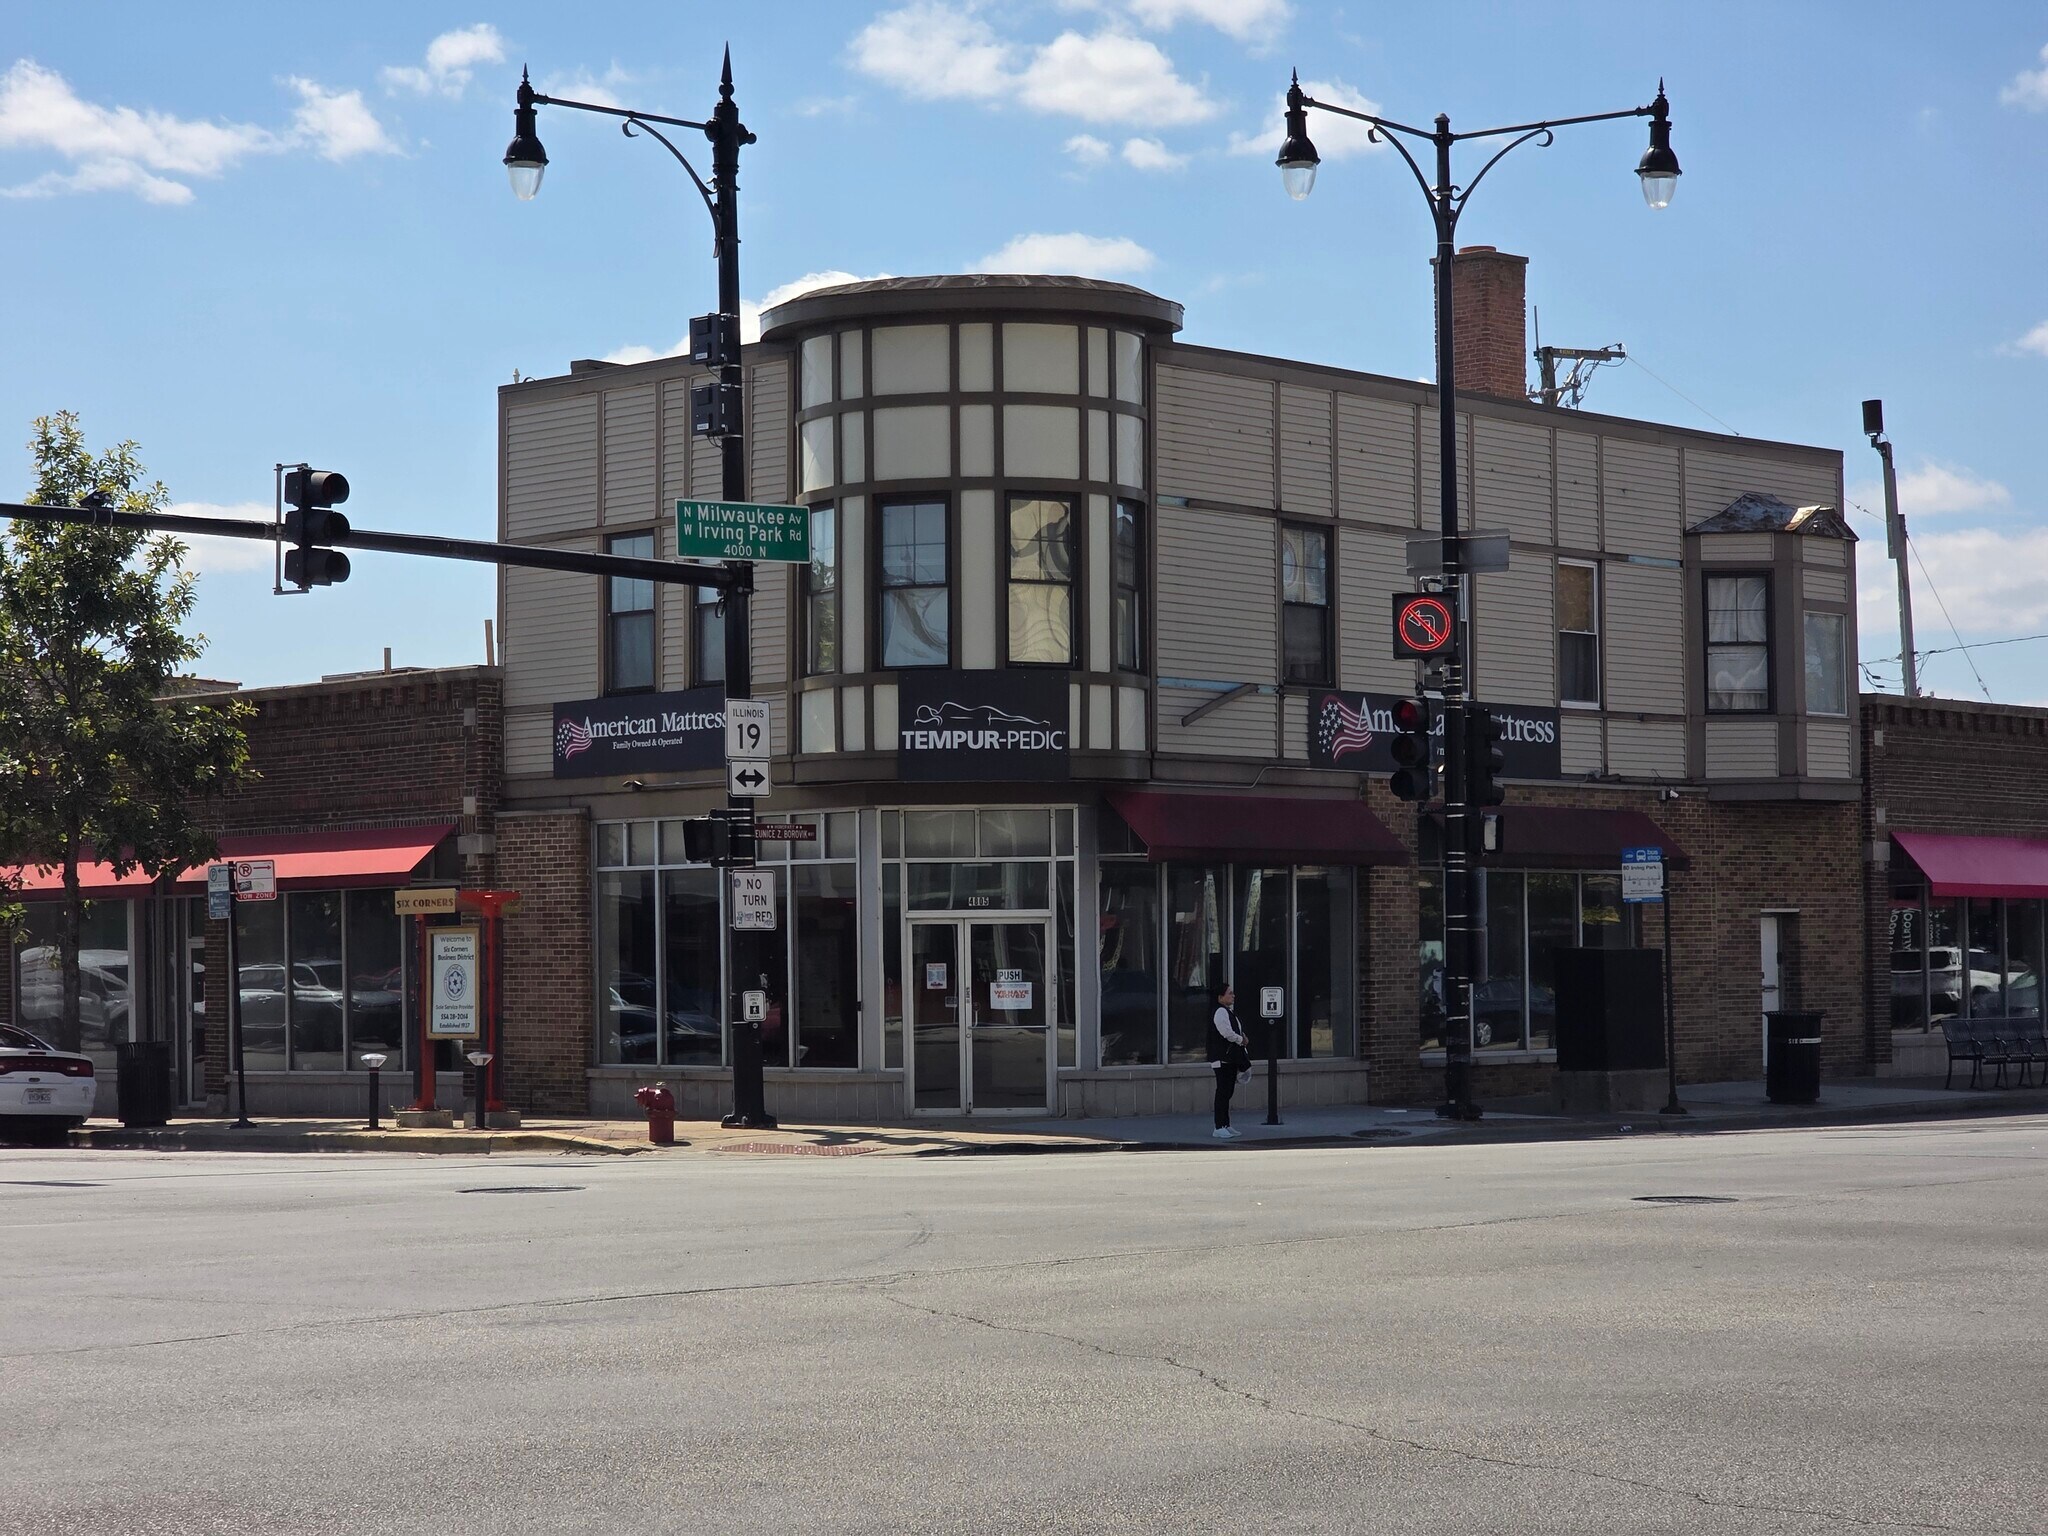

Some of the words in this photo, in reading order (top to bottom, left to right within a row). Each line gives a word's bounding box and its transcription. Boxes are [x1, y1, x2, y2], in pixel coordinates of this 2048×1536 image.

[684, 506, 692, 518] N
[697, 504, 785, 525] Milwaukee
[788, 512, 802, 525] Av
[684, 523, 692, 536] W
[698, 522, 744, 545] Irving
[749, 524, 783, 543] Park
[789, 529, 802, 541] Rd
[723, 544, 753, 557] 4000
[759, 546, 767, 557] N
[732, 708, 765, 719] ILLINOIS
[582, 715, 657, 740] American
[1499, 713, 1556, 744] ttress
[612, 741, 632, 751] Family
[631, 739, 652, 749] Owned
[657, 736, 683, 748] Operated
[737, 723, 761, 750] 19
[901, 730, 1063, 751] TEMPUR-PEDIC
[746, 878, 762, 890] NO
[396, 899, 410, 909] SIX
[412, 897, 454, 908] CORNERS
[742, 894, 767, 906] TURN
[968, 897, 989, 906] 4805
[999, 970, 1020, 981] PUSH
